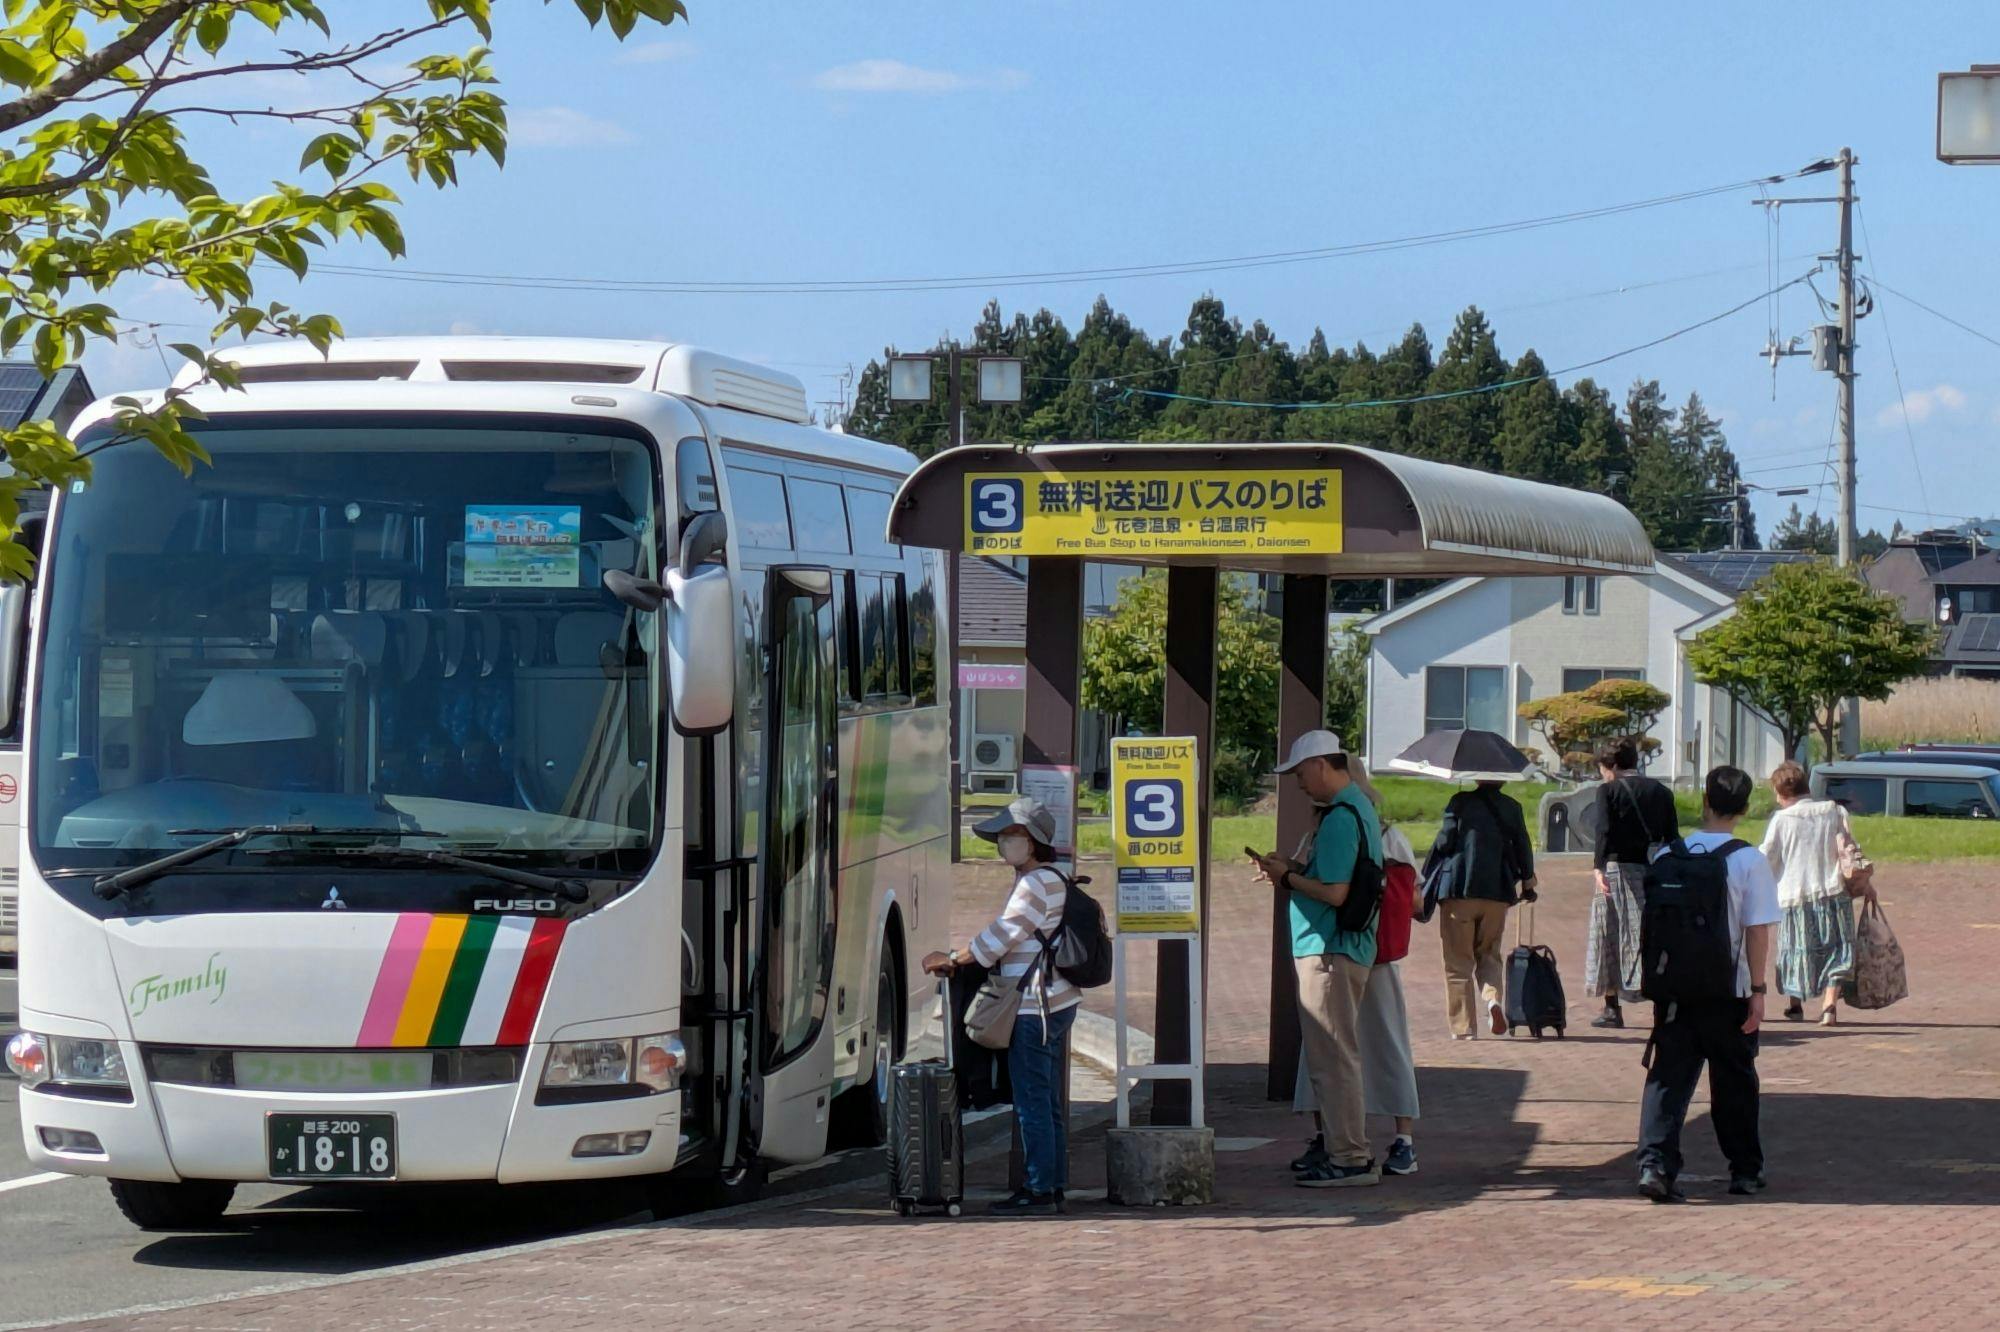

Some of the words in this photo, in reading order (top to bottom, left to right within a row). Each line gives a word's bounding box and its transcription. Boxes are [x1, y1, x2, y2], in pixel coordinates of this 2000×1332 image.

[1038, 478, 1329, 513] 無料送迎バスのりば
[978, 483, 1016, 527] 3
[1114, 516, 1267, 534] 花巻温泉・台温泉行
[973, 536, 1023, 550] 番のりば
[1056, 538, 1082, 548] Free
[1085, 538, 1107, 548] Bus
[1110, 538, 1136, 549] Stop
[1140, 538, 1151, 548] to
[1118, 745, 1189, 760] 無料送迎バス
[1134, 784, 1176, 831] 3
[1128, 841, 1184, 856] 番のりば
[473, 899, 557, 911] FUSO
[130, 952, 228, 1018] Family
[297, 1135, 389, 1172] 18-18
